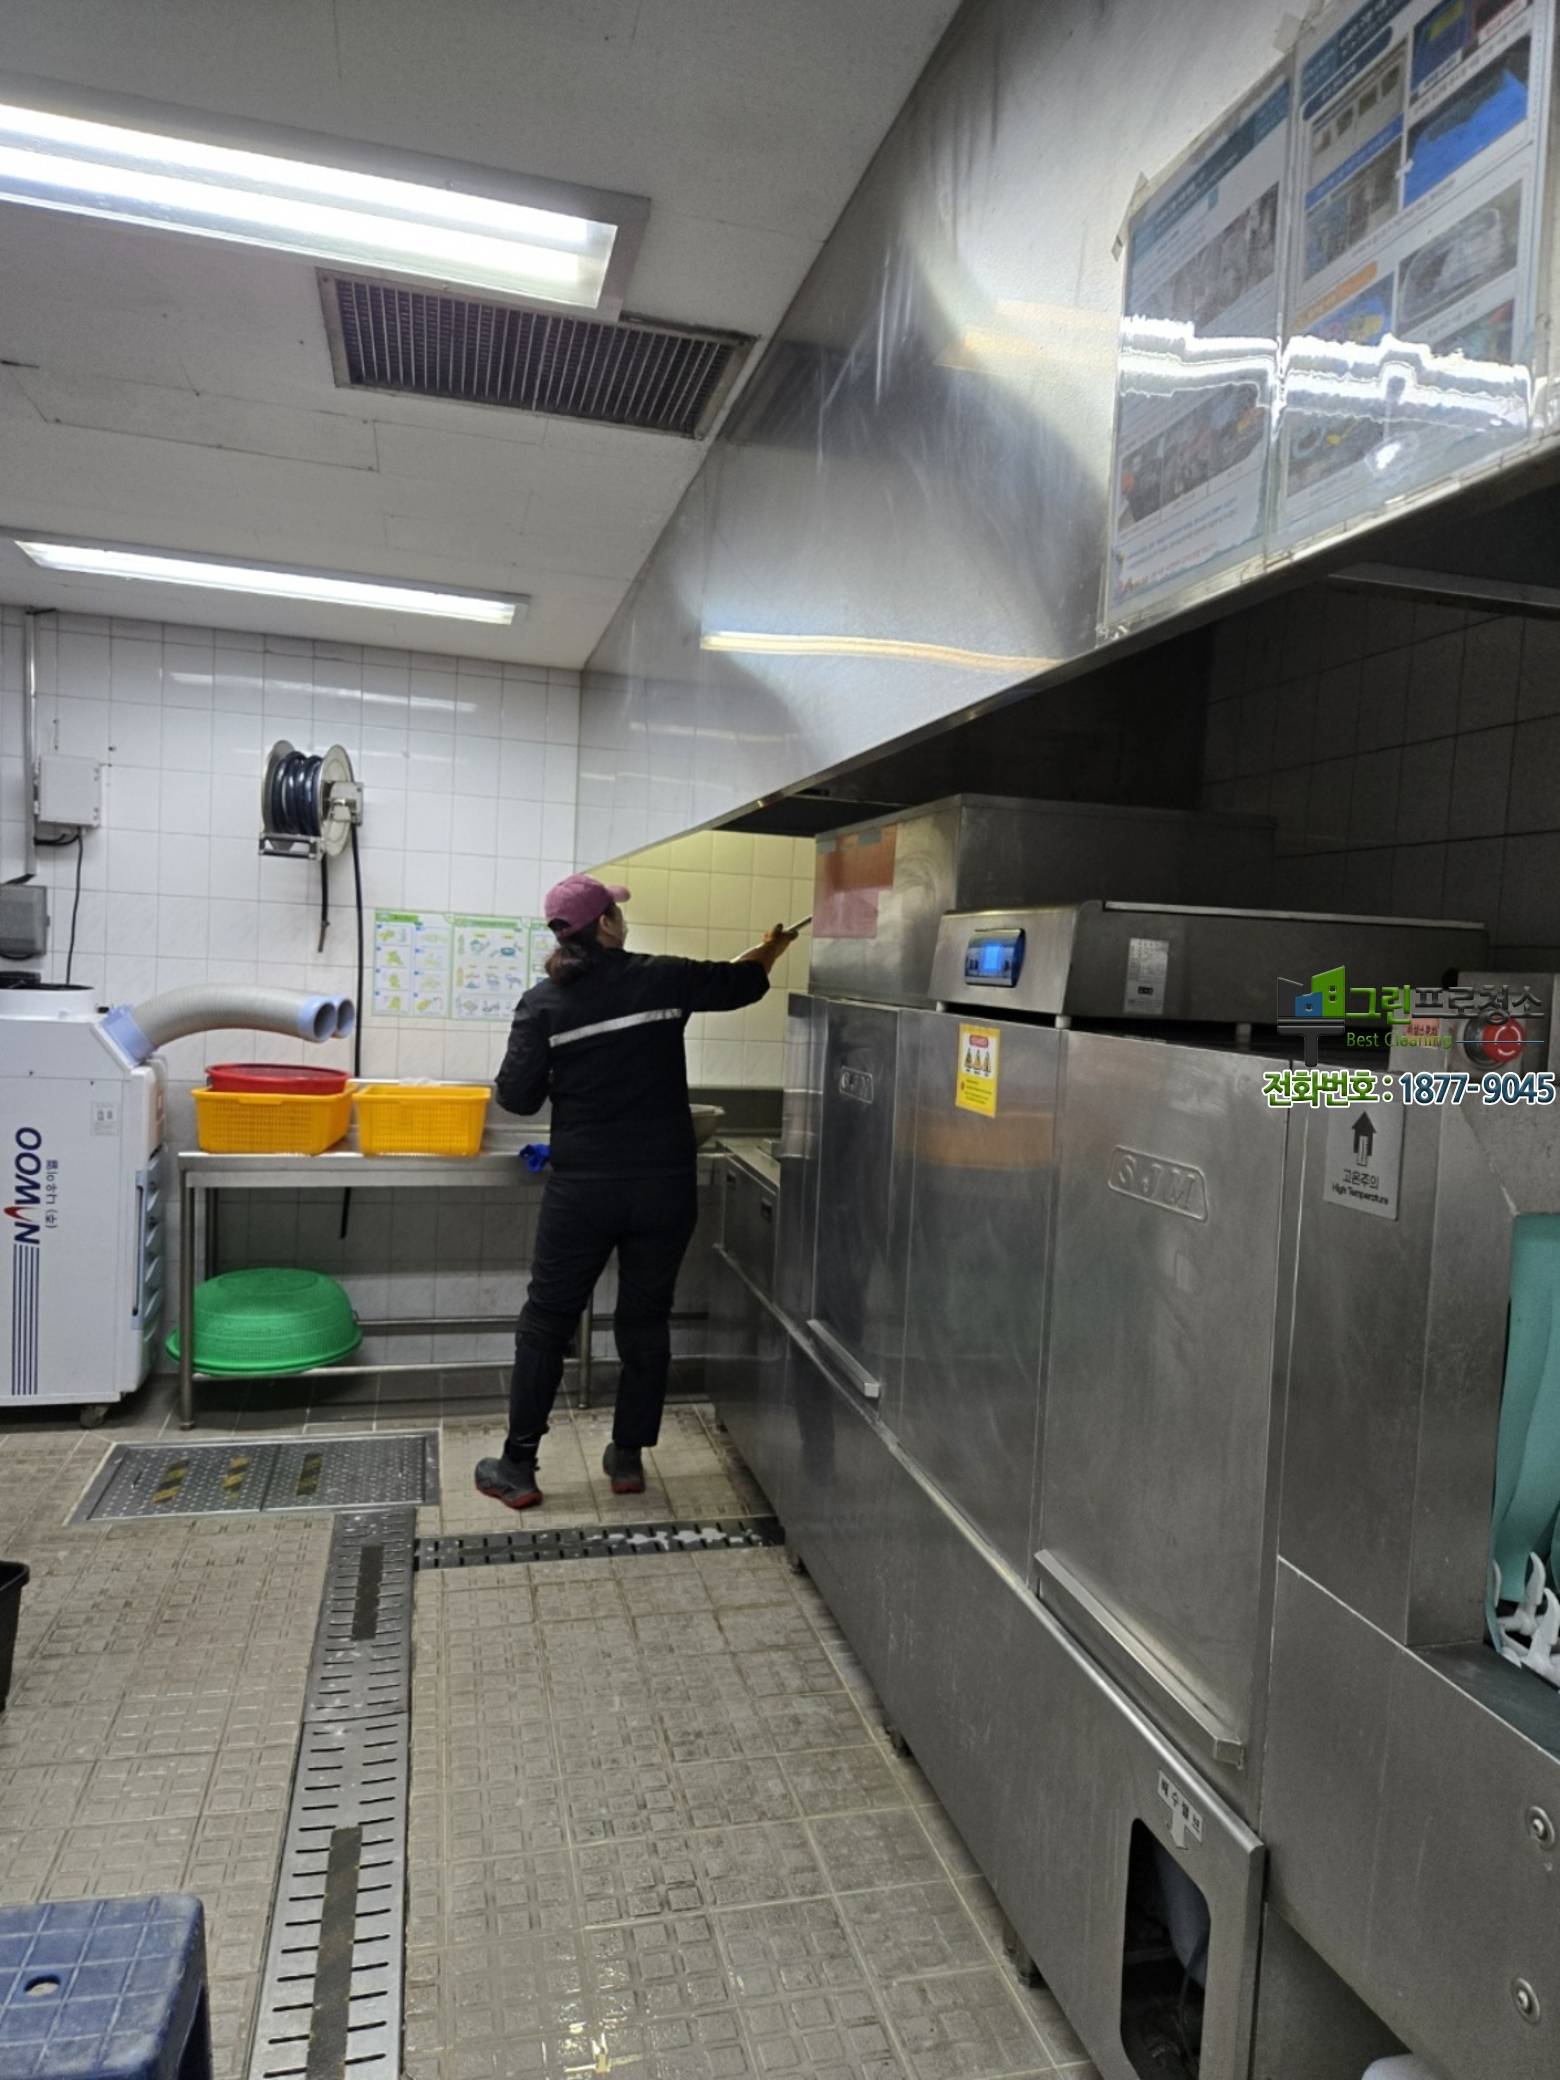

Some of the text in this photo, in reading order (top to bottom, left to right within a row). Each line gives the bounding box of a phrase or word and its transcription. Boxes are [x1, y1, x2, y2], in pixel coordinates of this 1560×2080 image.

[3, 1127, 42, 1245] NAWOO
[1343, 1168, 1380, 1190] 고온주의
[1332, 1183, 1389, 1206] High Temperature
